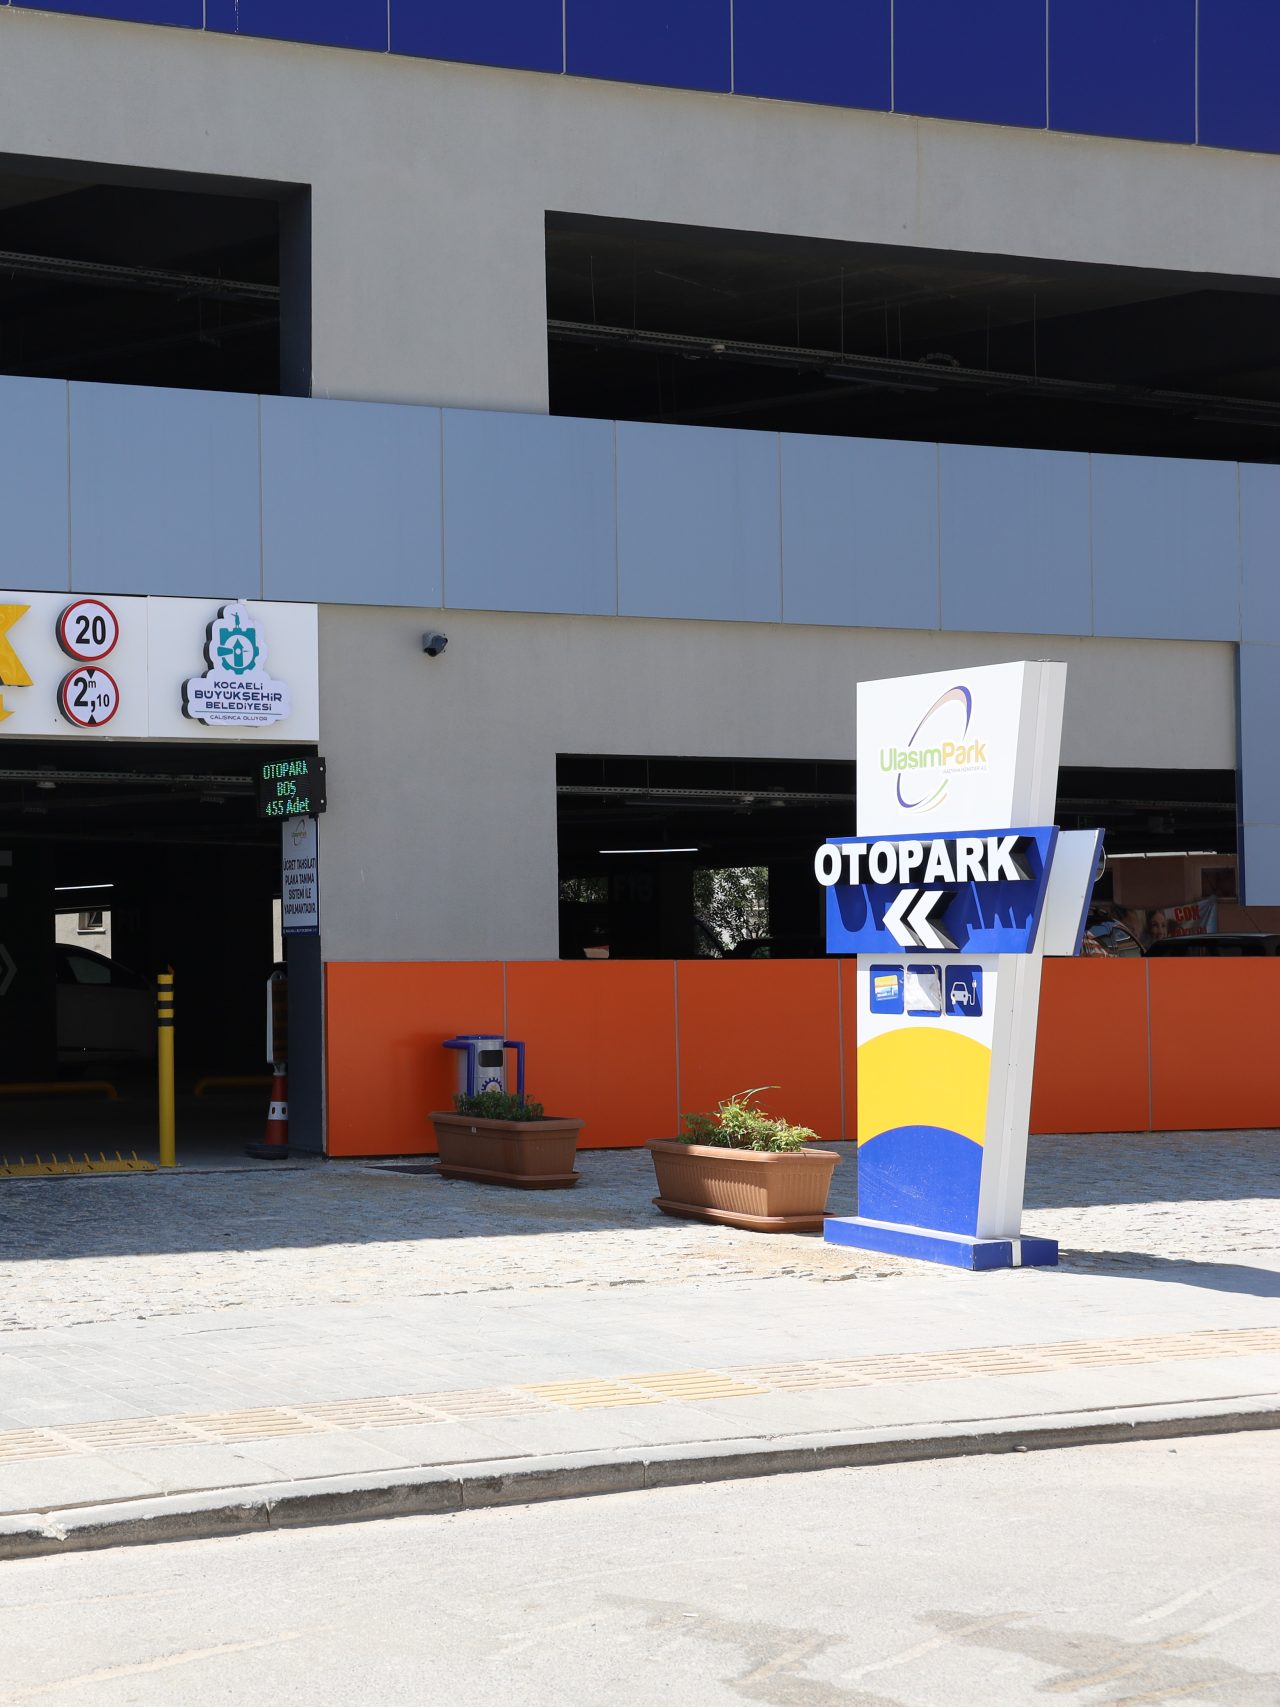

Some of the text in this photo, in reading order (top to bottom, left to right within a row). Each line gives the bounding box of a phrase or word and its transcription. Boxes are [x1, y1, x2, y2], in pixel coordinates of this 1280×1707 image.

[75, 615, 106, 645] 20
[214, 681, 263, 690] KOCAELİ
[194, 690, 283, 702] BÜYÜKŞEHİR
[206, 701, 272, 711] BELEDİYESİ
[263, 760, 308, 780] OTOPARK
[265, 797, 310, 816] 455 Adet
[814, 835, 1020, 886] OTOPARK
